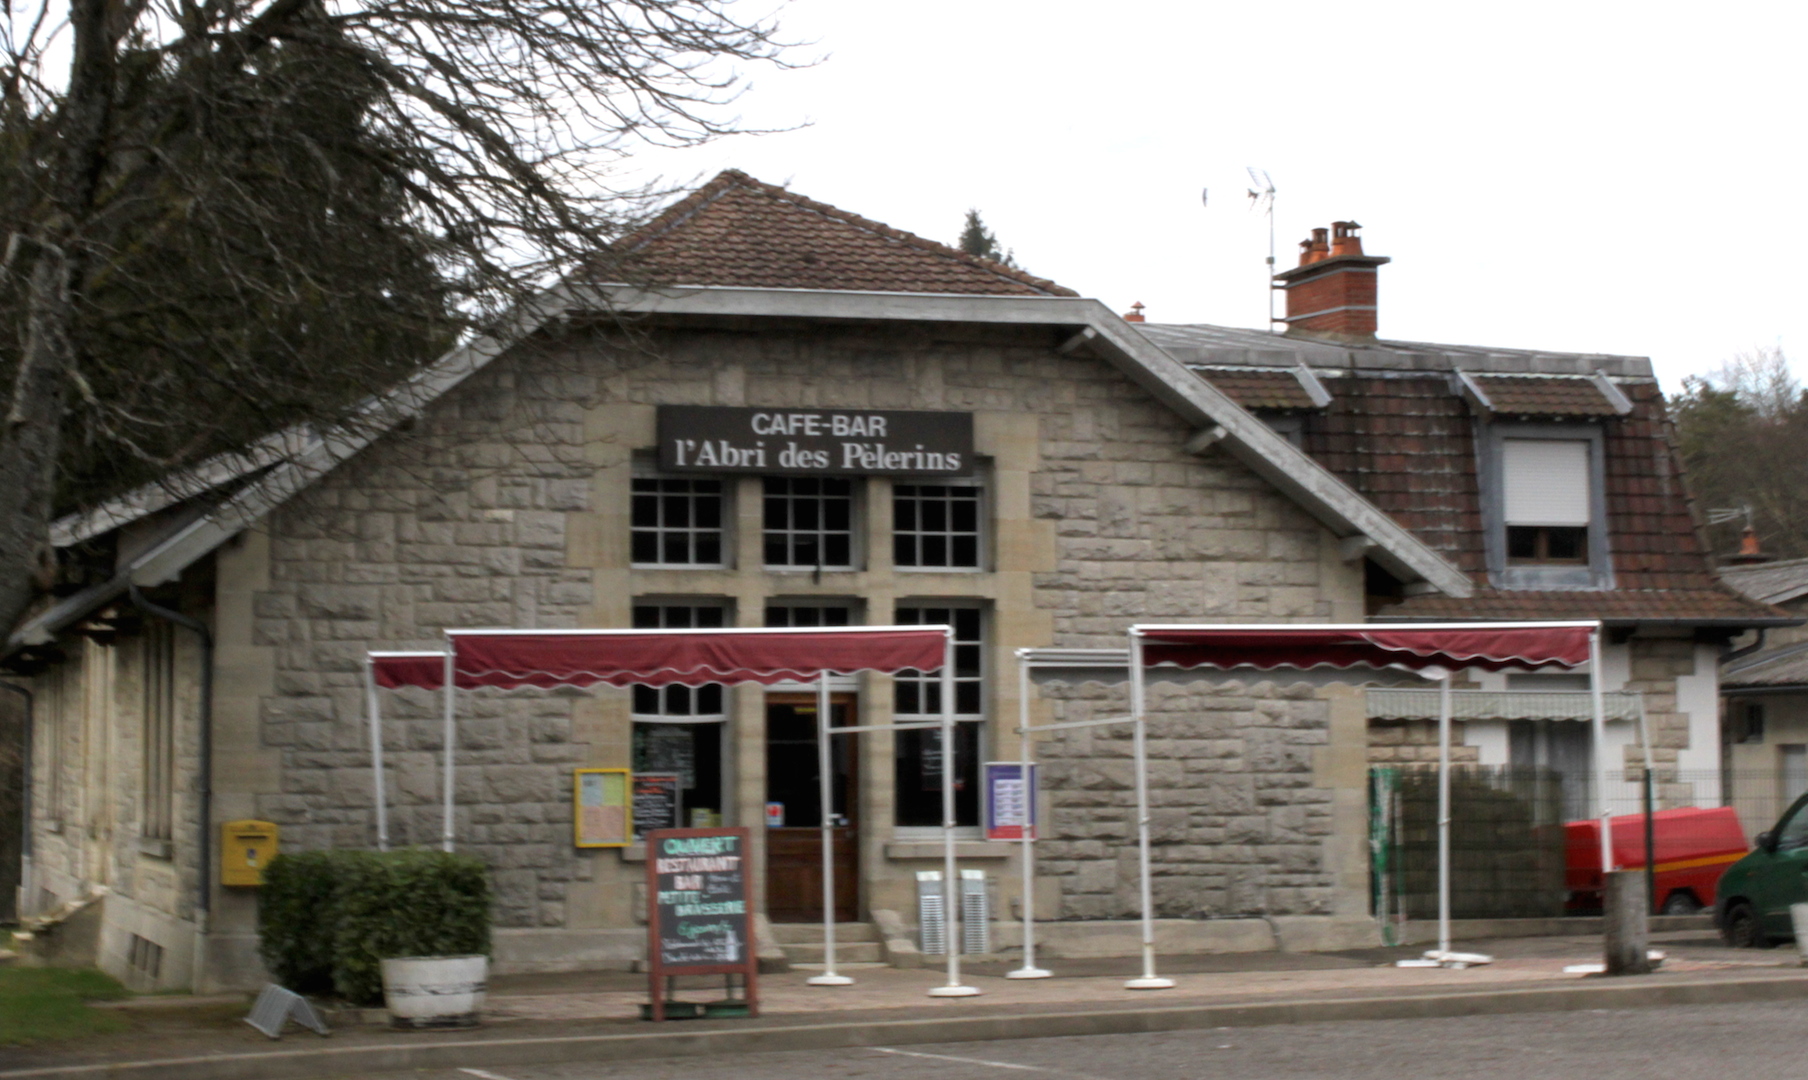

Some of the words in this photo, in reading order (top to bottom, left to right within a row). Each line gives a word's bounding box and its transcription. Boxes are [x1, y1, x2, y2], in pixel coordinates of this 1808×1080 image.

[751, 412, 887, 437] CAFE-BAR
[674, 439, 767, 467] l'Abri
[778, 441, 830, 469] des
[841, 442, 962, 471] Pèlerins
[663, 836, 739, 856] OUVERT
[673, 874, 703, 890] BAR
